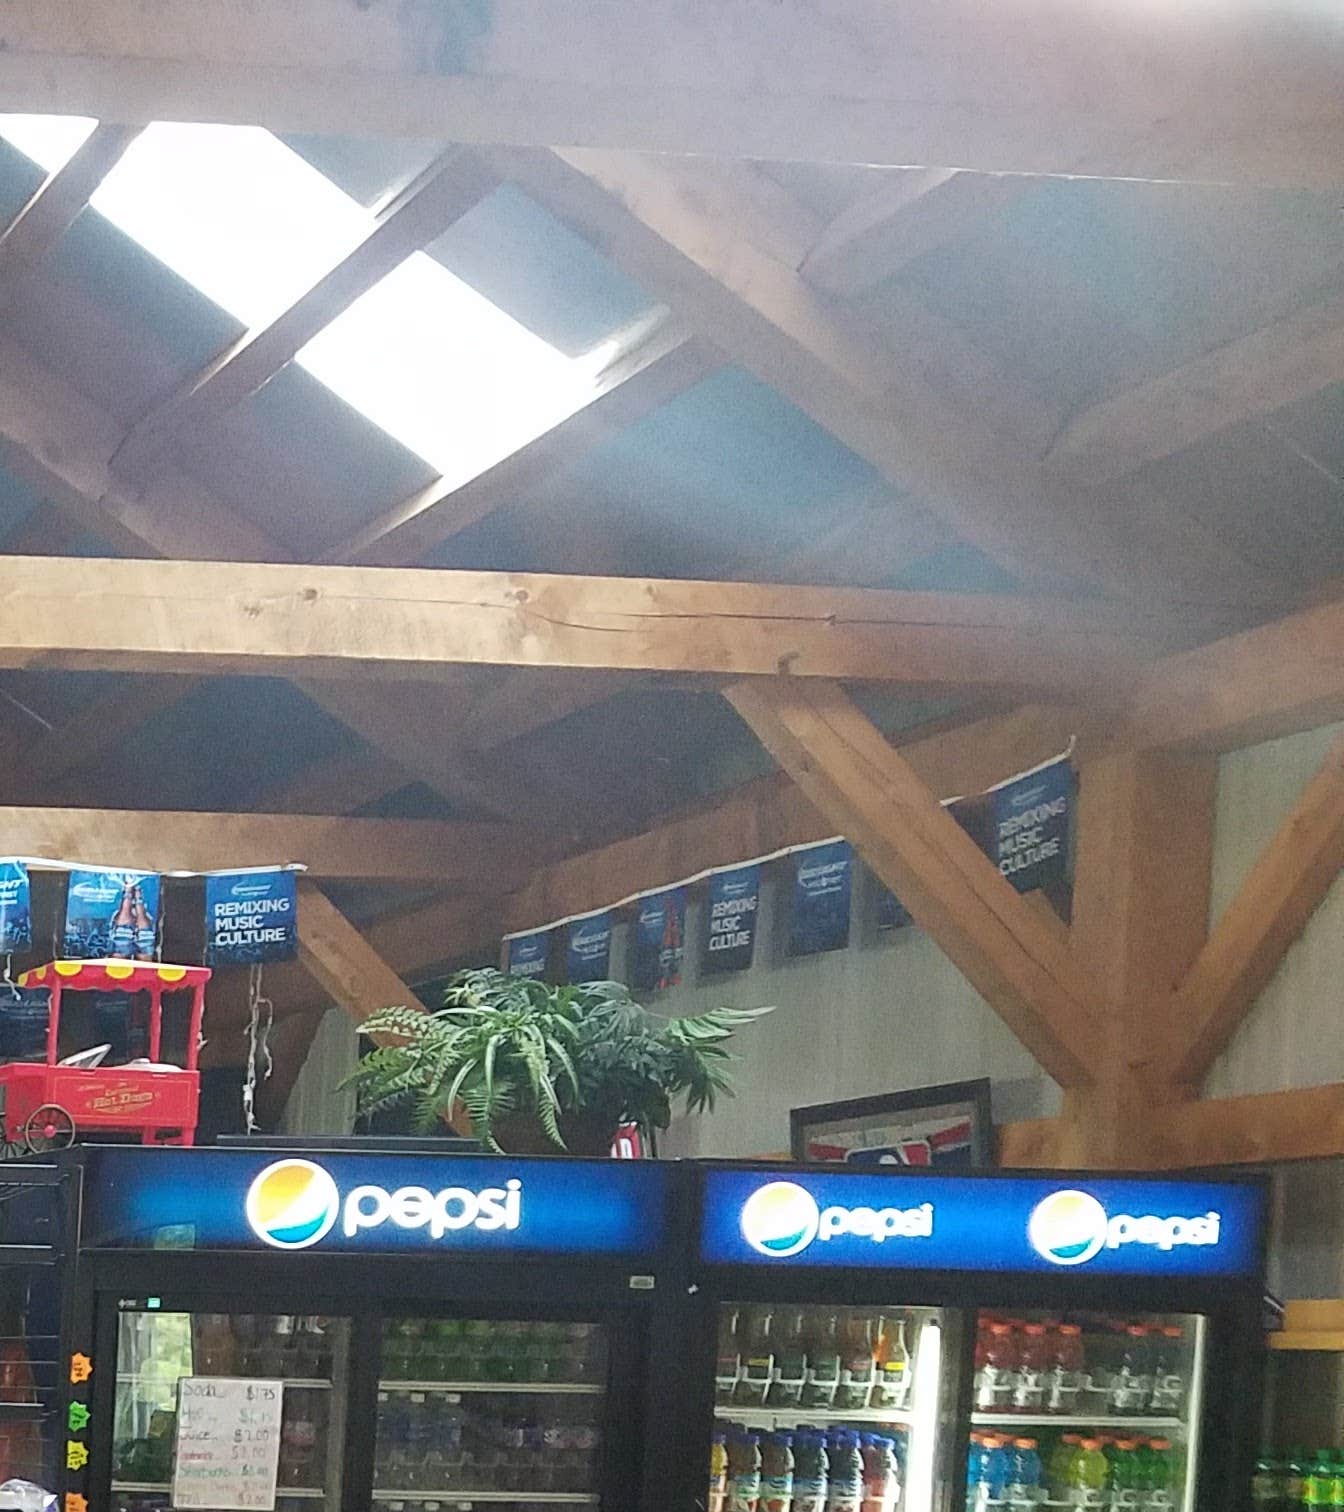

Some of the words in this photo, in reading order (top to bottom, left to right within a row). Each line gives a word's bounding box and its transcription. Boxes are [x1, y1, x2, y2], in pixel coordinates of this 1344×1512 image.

[216, 900, 289, 915] REMIXING
[216, 916, 263, 930] MUSIC
[216, 928, 286, 945] CULTURE
[345, 1179, 521, 1239] pepsi
[819, 1203, 933, 1243] pepsi
[1107, 1211, 1220, 1250] pepsi
